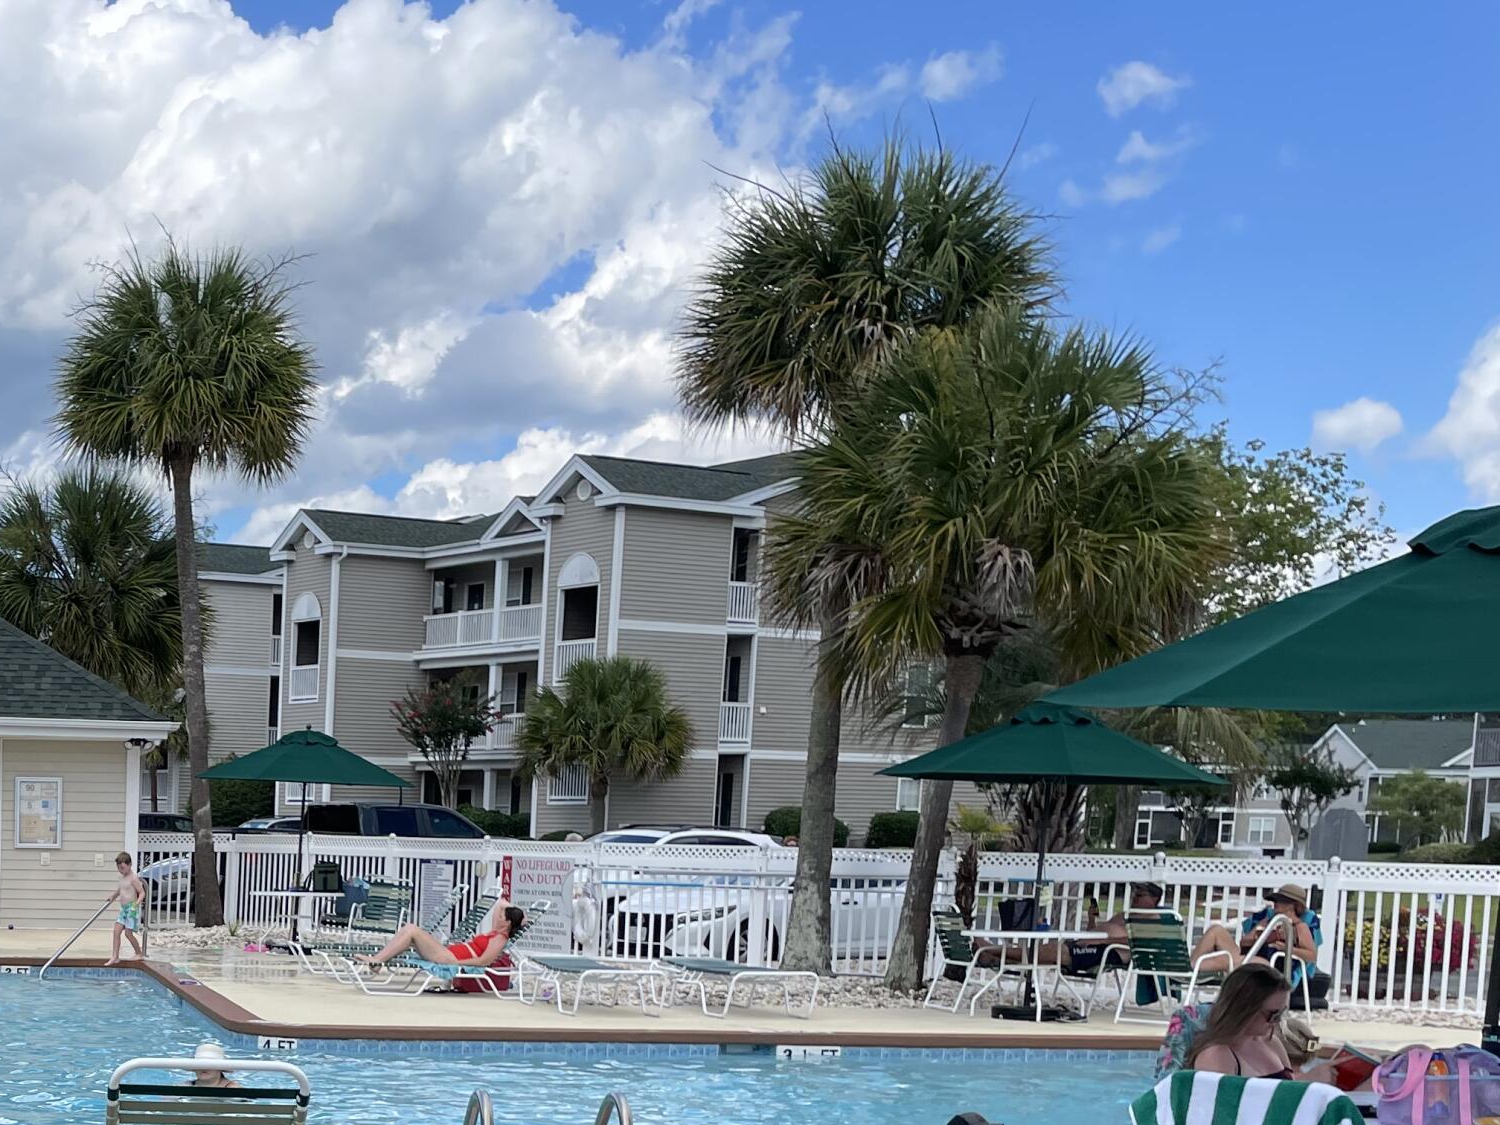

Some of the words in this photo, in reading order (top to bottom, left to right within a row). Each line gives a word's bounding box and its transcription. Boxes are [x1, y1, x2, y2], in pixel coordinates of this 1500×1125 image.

[516, 860, 528, 870] NO
[529, 860, 571, 872] LIFEGUARD
[520, 873, 534, 884] ON
[537, 874, 563, 885] DUTY
